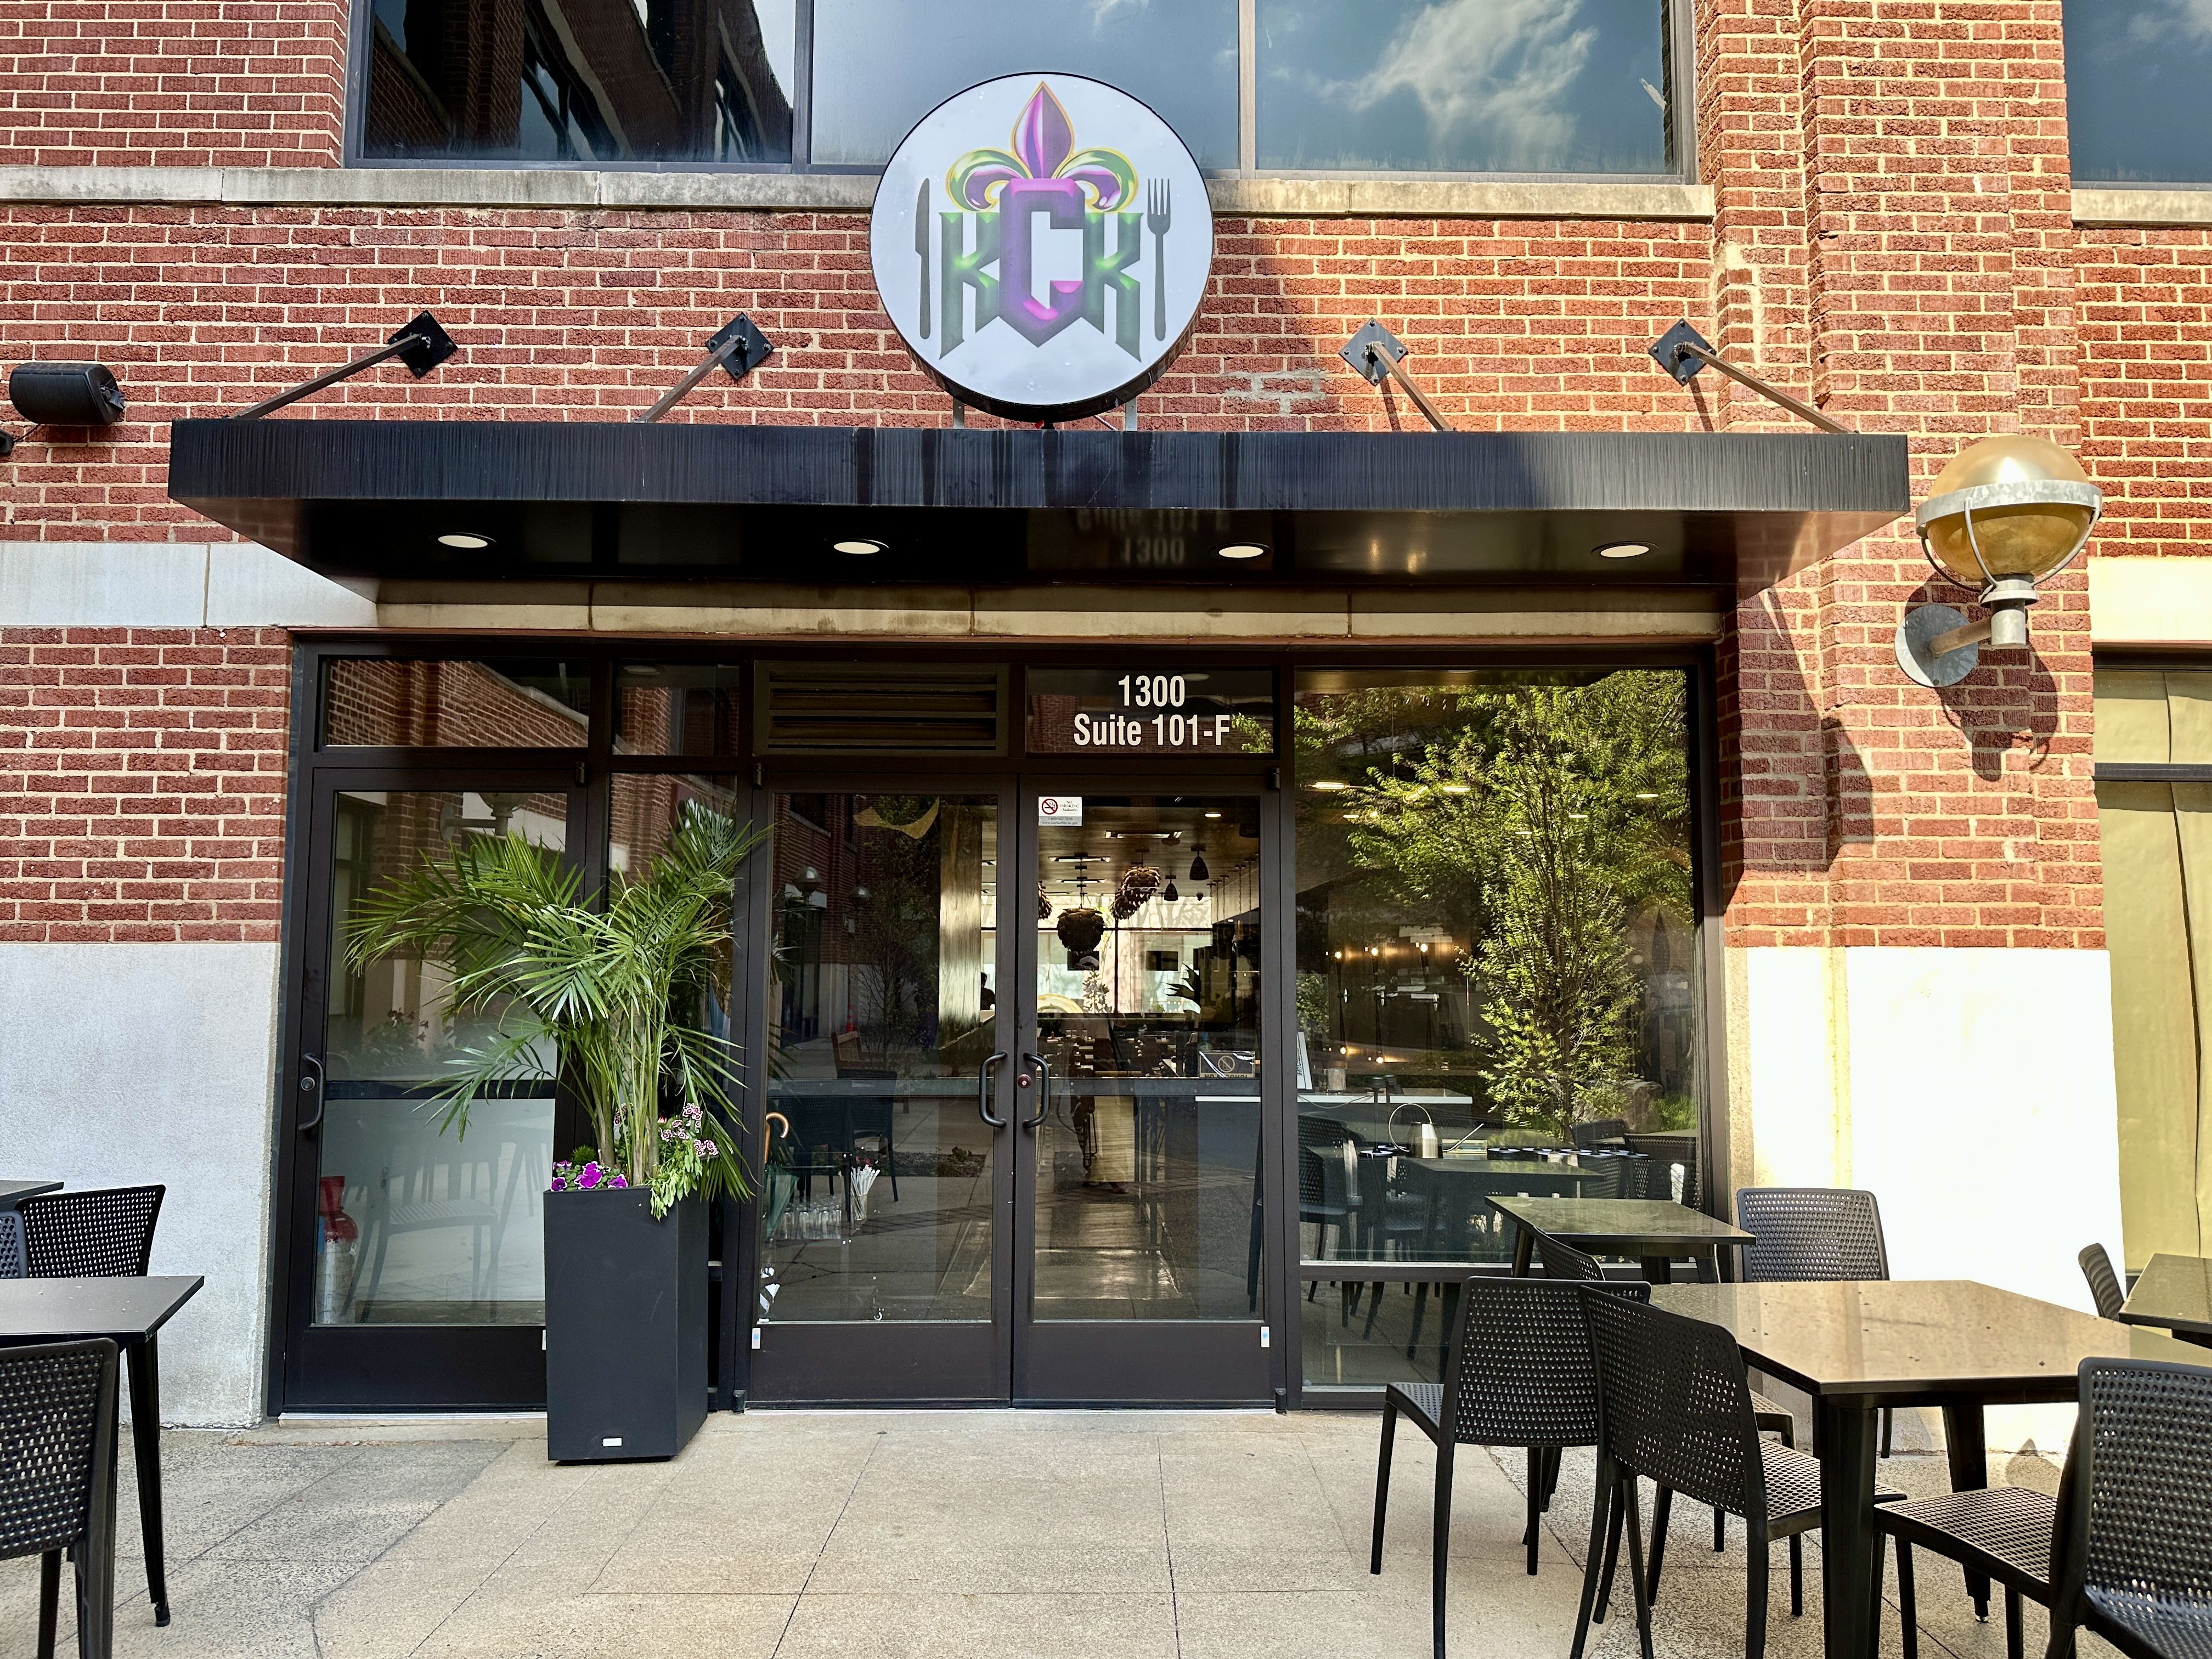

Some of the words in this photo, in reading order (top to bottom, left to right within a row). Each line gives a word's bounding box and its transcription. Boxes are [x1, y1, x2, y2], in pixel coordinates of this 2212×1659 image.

[939, 177, 1142, 363] KCK
[1118, 675, 1186, 707] 1300
[1073, 713, 1142, 746] Suite
[1151, 714, 1231, 746] 101-F
